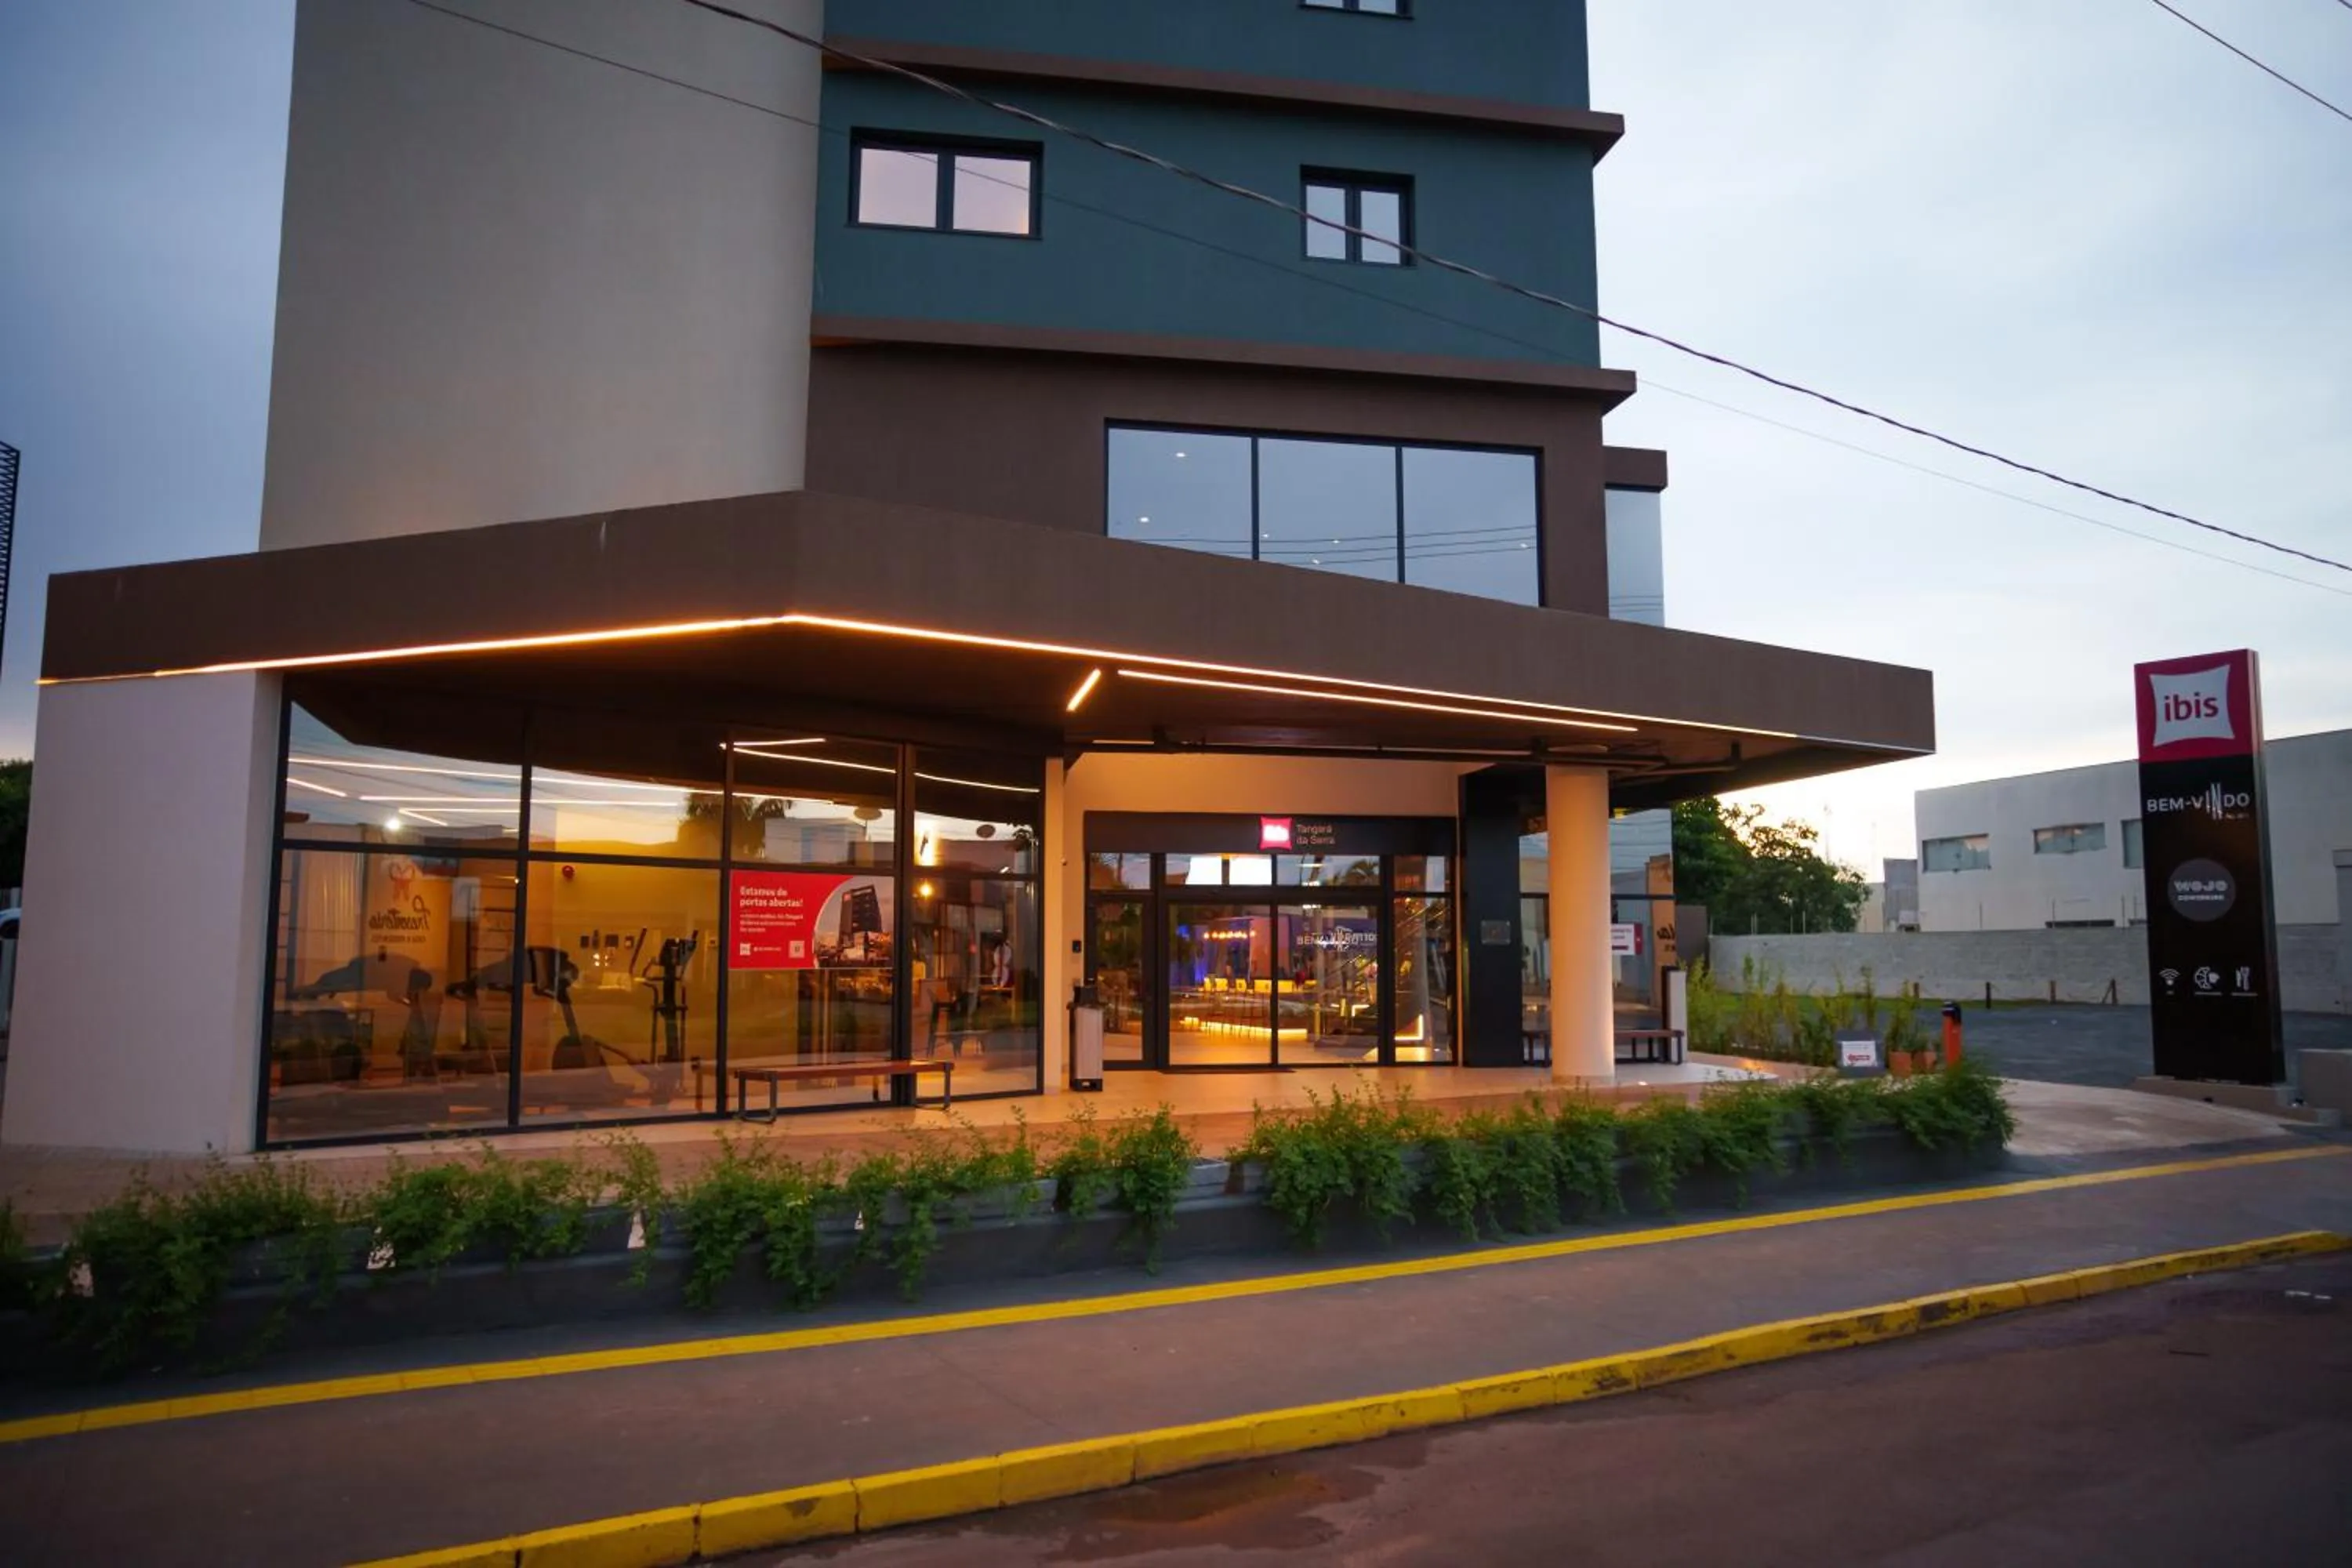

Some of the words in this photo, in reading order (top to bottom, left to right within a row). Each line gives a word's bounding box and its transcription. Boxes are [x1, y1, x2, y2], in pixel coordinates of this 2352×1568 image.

[2164, 691, 2219, 722] ibis
[2147, 782, 2251, 820] BEM-VINDO
[1296, 836, 1308, 845] da
[740, 898, 768, 908] portas
